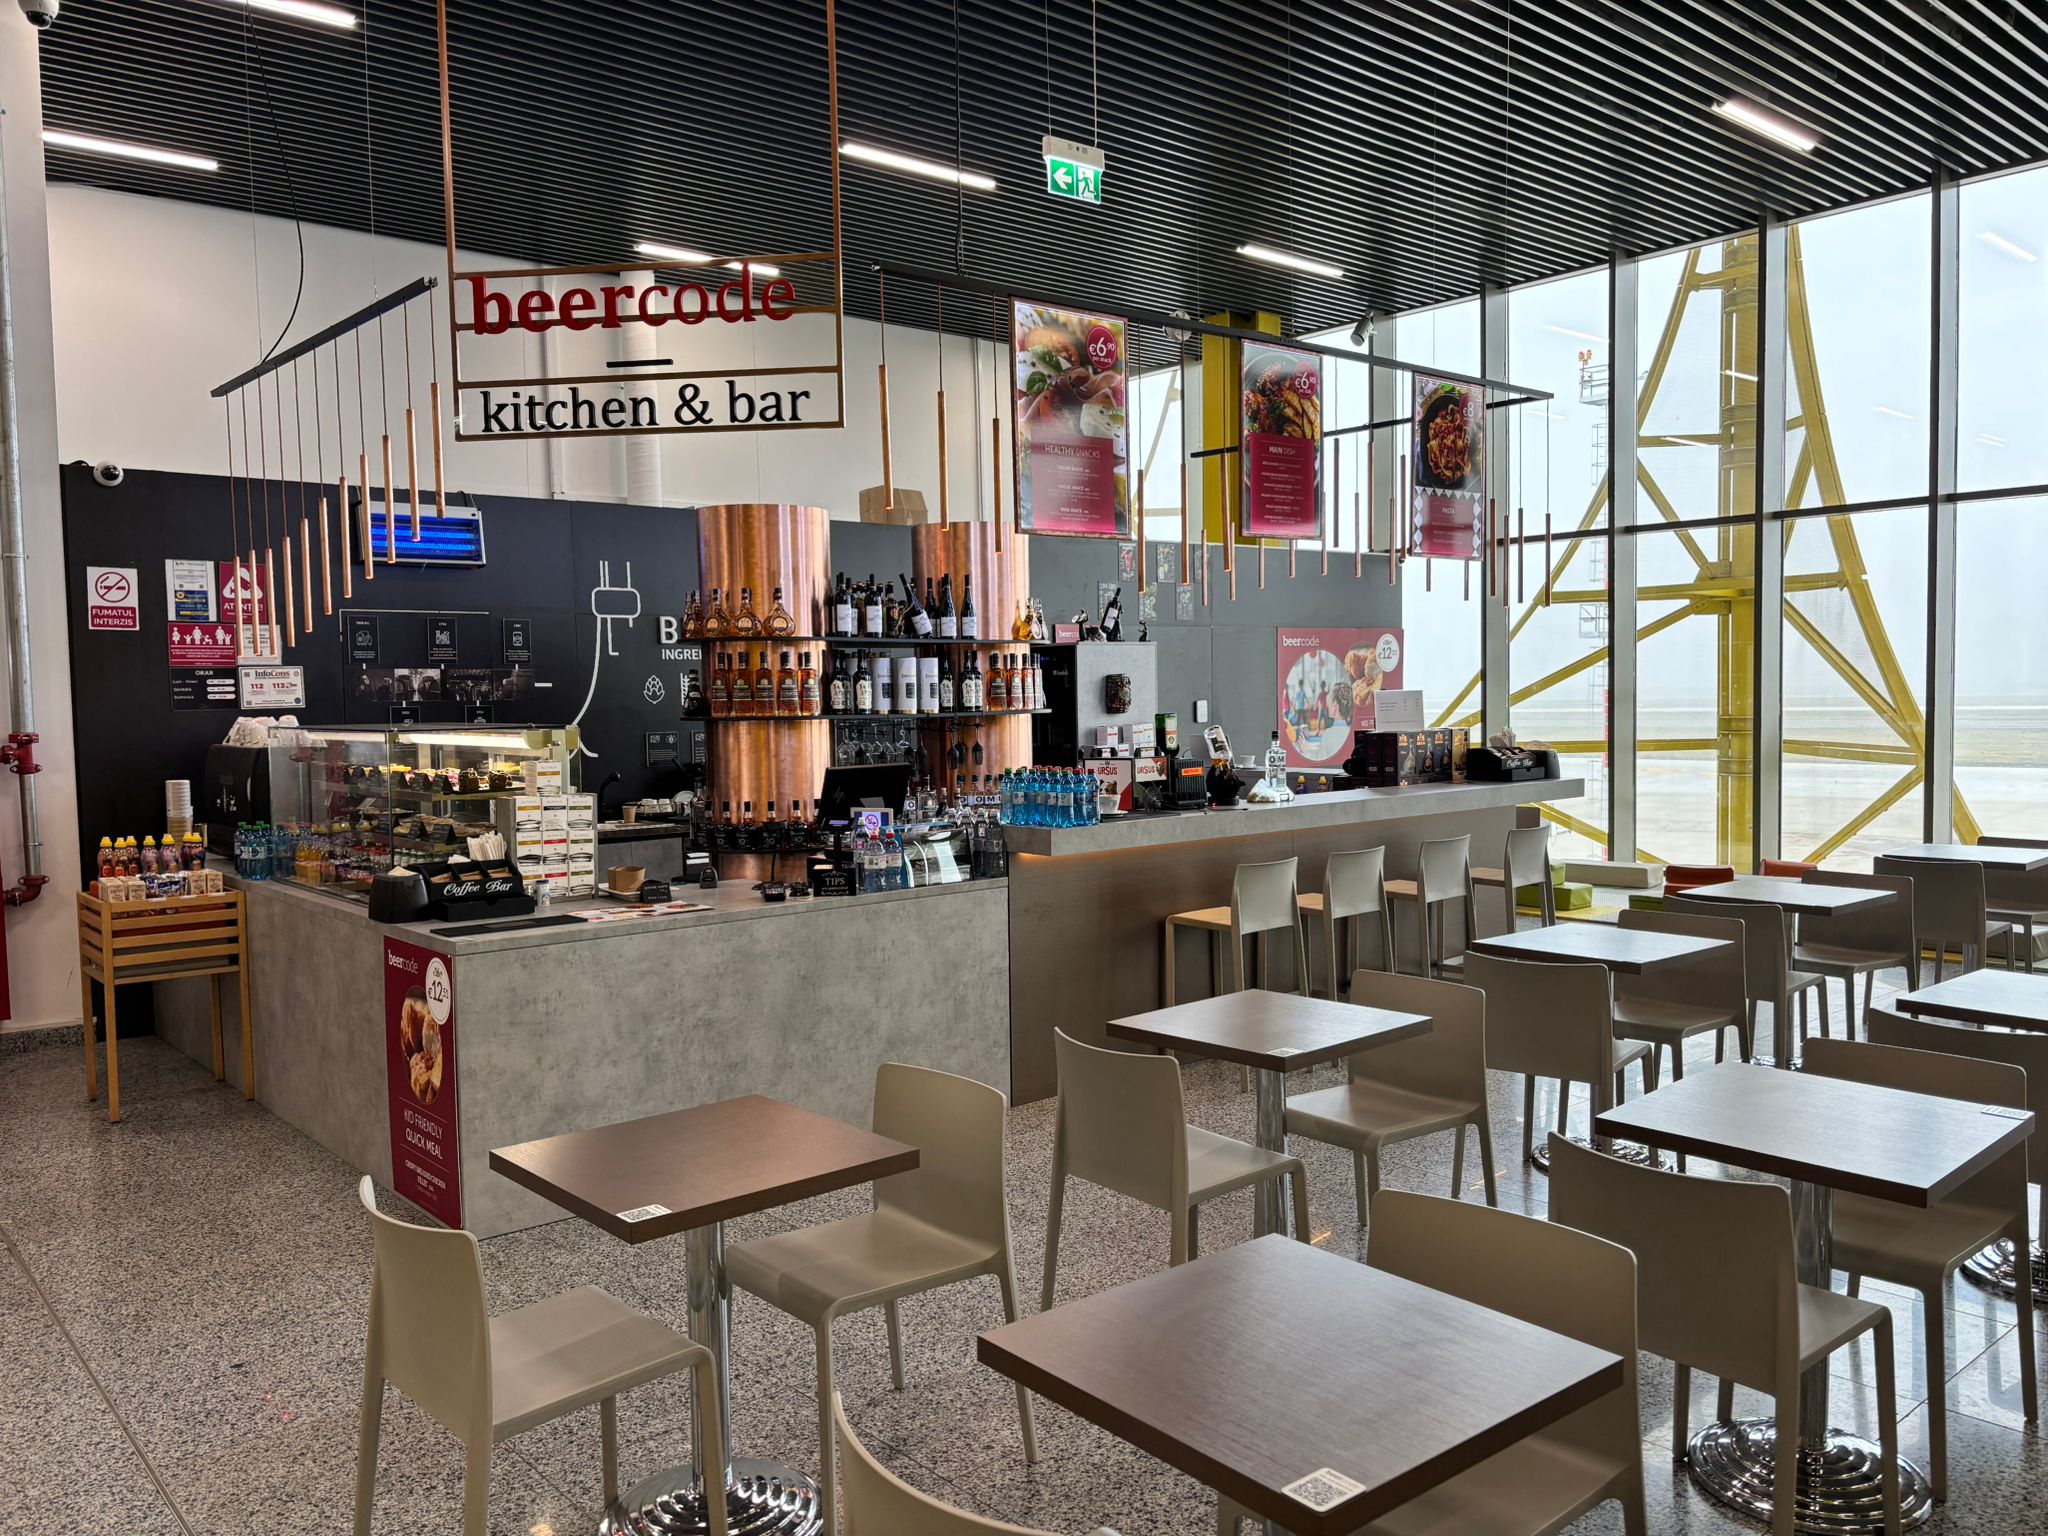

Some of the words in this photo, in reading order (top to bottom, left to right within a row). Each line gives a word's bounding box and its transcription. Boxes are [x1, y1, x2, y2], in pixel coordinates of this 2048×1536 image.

[468, 261, 795, 334] beercode
[480, 386, 659, 433] kitchen
[674, 383, 712, 425] &
[725, 380, 810, 424] bar
[1045, 445, 1075, 456] HEALTHY
[1076, 448, 1100, 458] SNACKS
[1269, 446, 1282, 454] MAIN
[92, 608, 134, 617] FUMATUL
[94, 618, 134, 626] INTERZIS
[1282, 635, 1320, 647] beercode
[1098, 766, 1118, 775] URSUS
[1137, 766, 1155, 774] URSUS
[444, 882, 480, 896] Coffee
[486, 880, 512, 893] Bar
[825, 878, 845, 886] TIPS
[388, 949, 418, 974] beercode
[404, 1108, 414, 1124] KID
[415, 1114, 442, 1139] FRIENDLY
[406, 1128, 425, 1150] QUICK
[426, 1138, 442, 1160] MEAL
